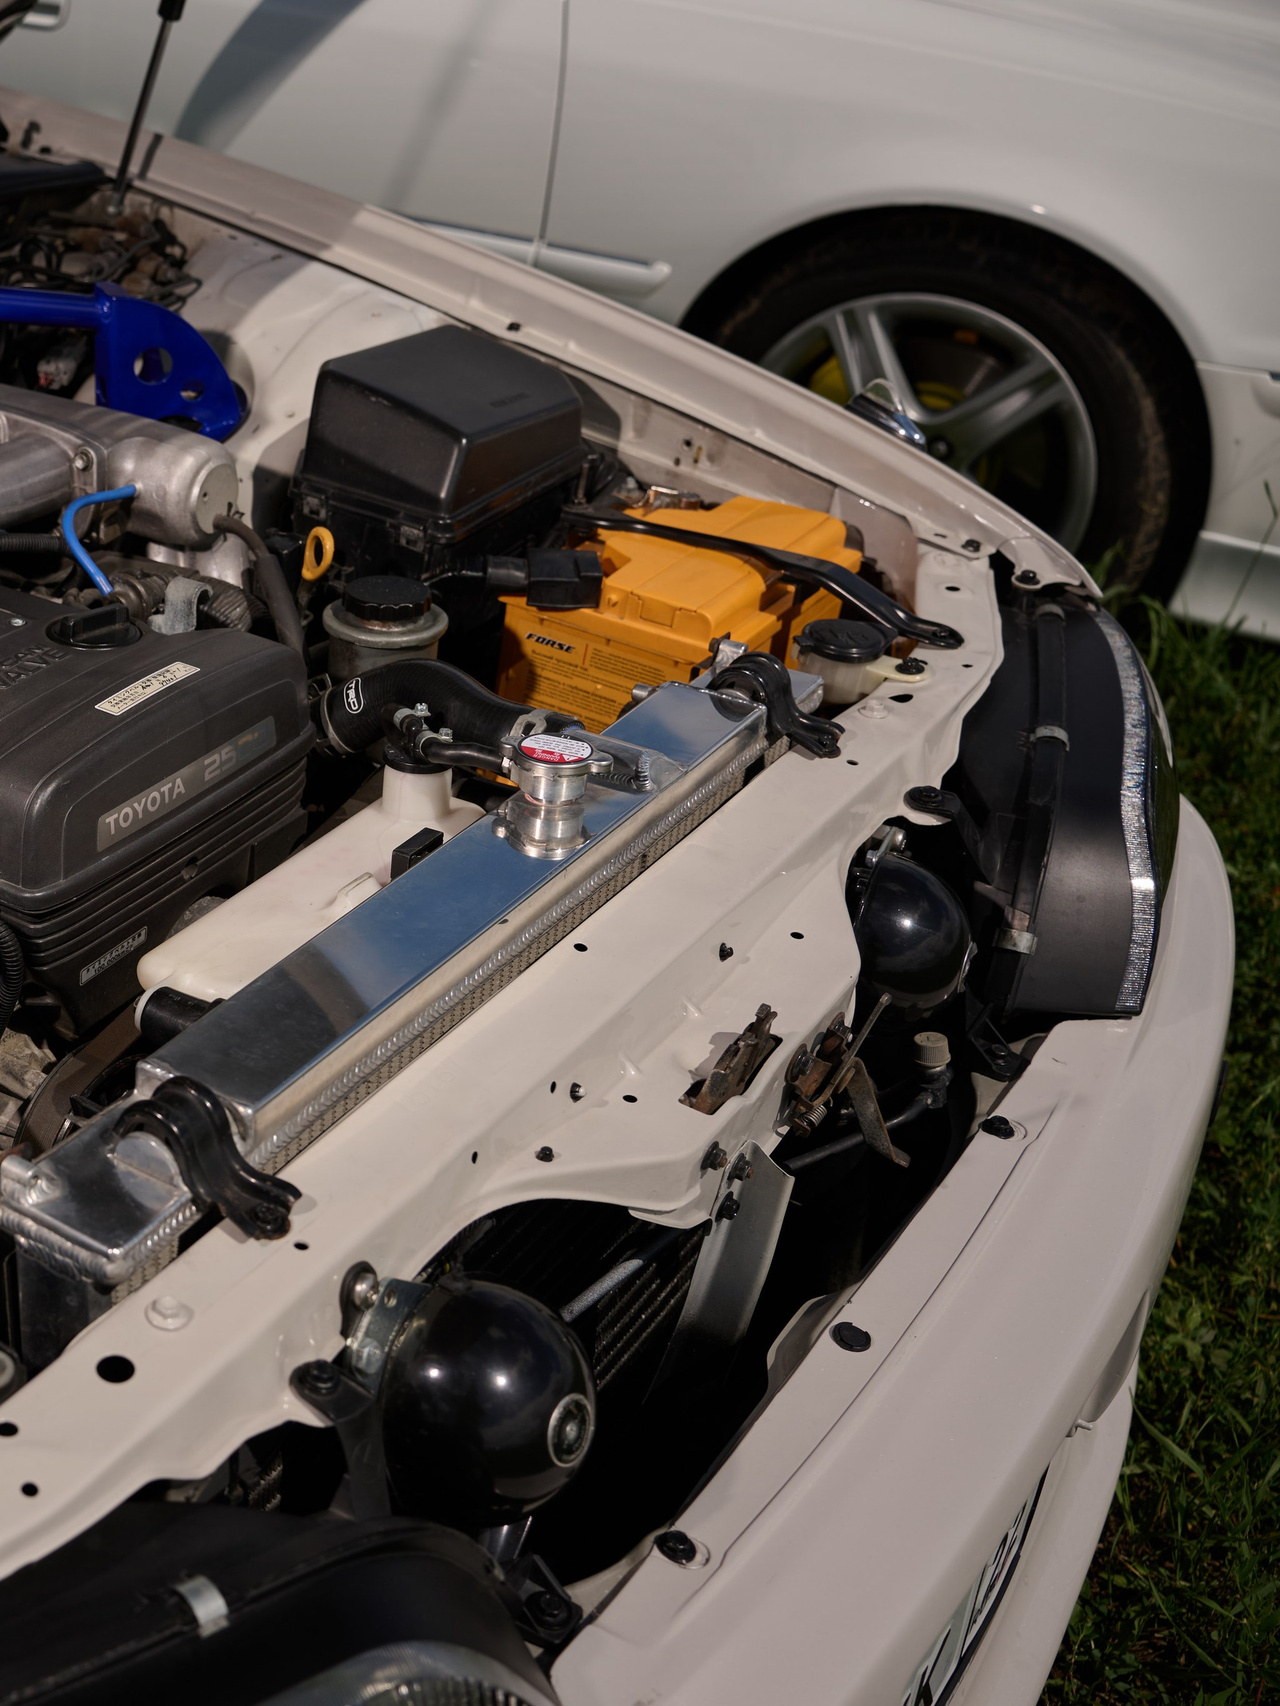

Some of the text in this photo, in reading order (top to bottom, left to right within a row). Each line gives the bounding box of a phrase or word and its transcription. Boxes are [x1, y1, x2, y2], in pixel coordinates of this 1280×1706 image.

[525, 632, 576, 654] FORSE
[347, 680, 359, 711] TRD
[105, 777, 186, 835] TOYOTA
